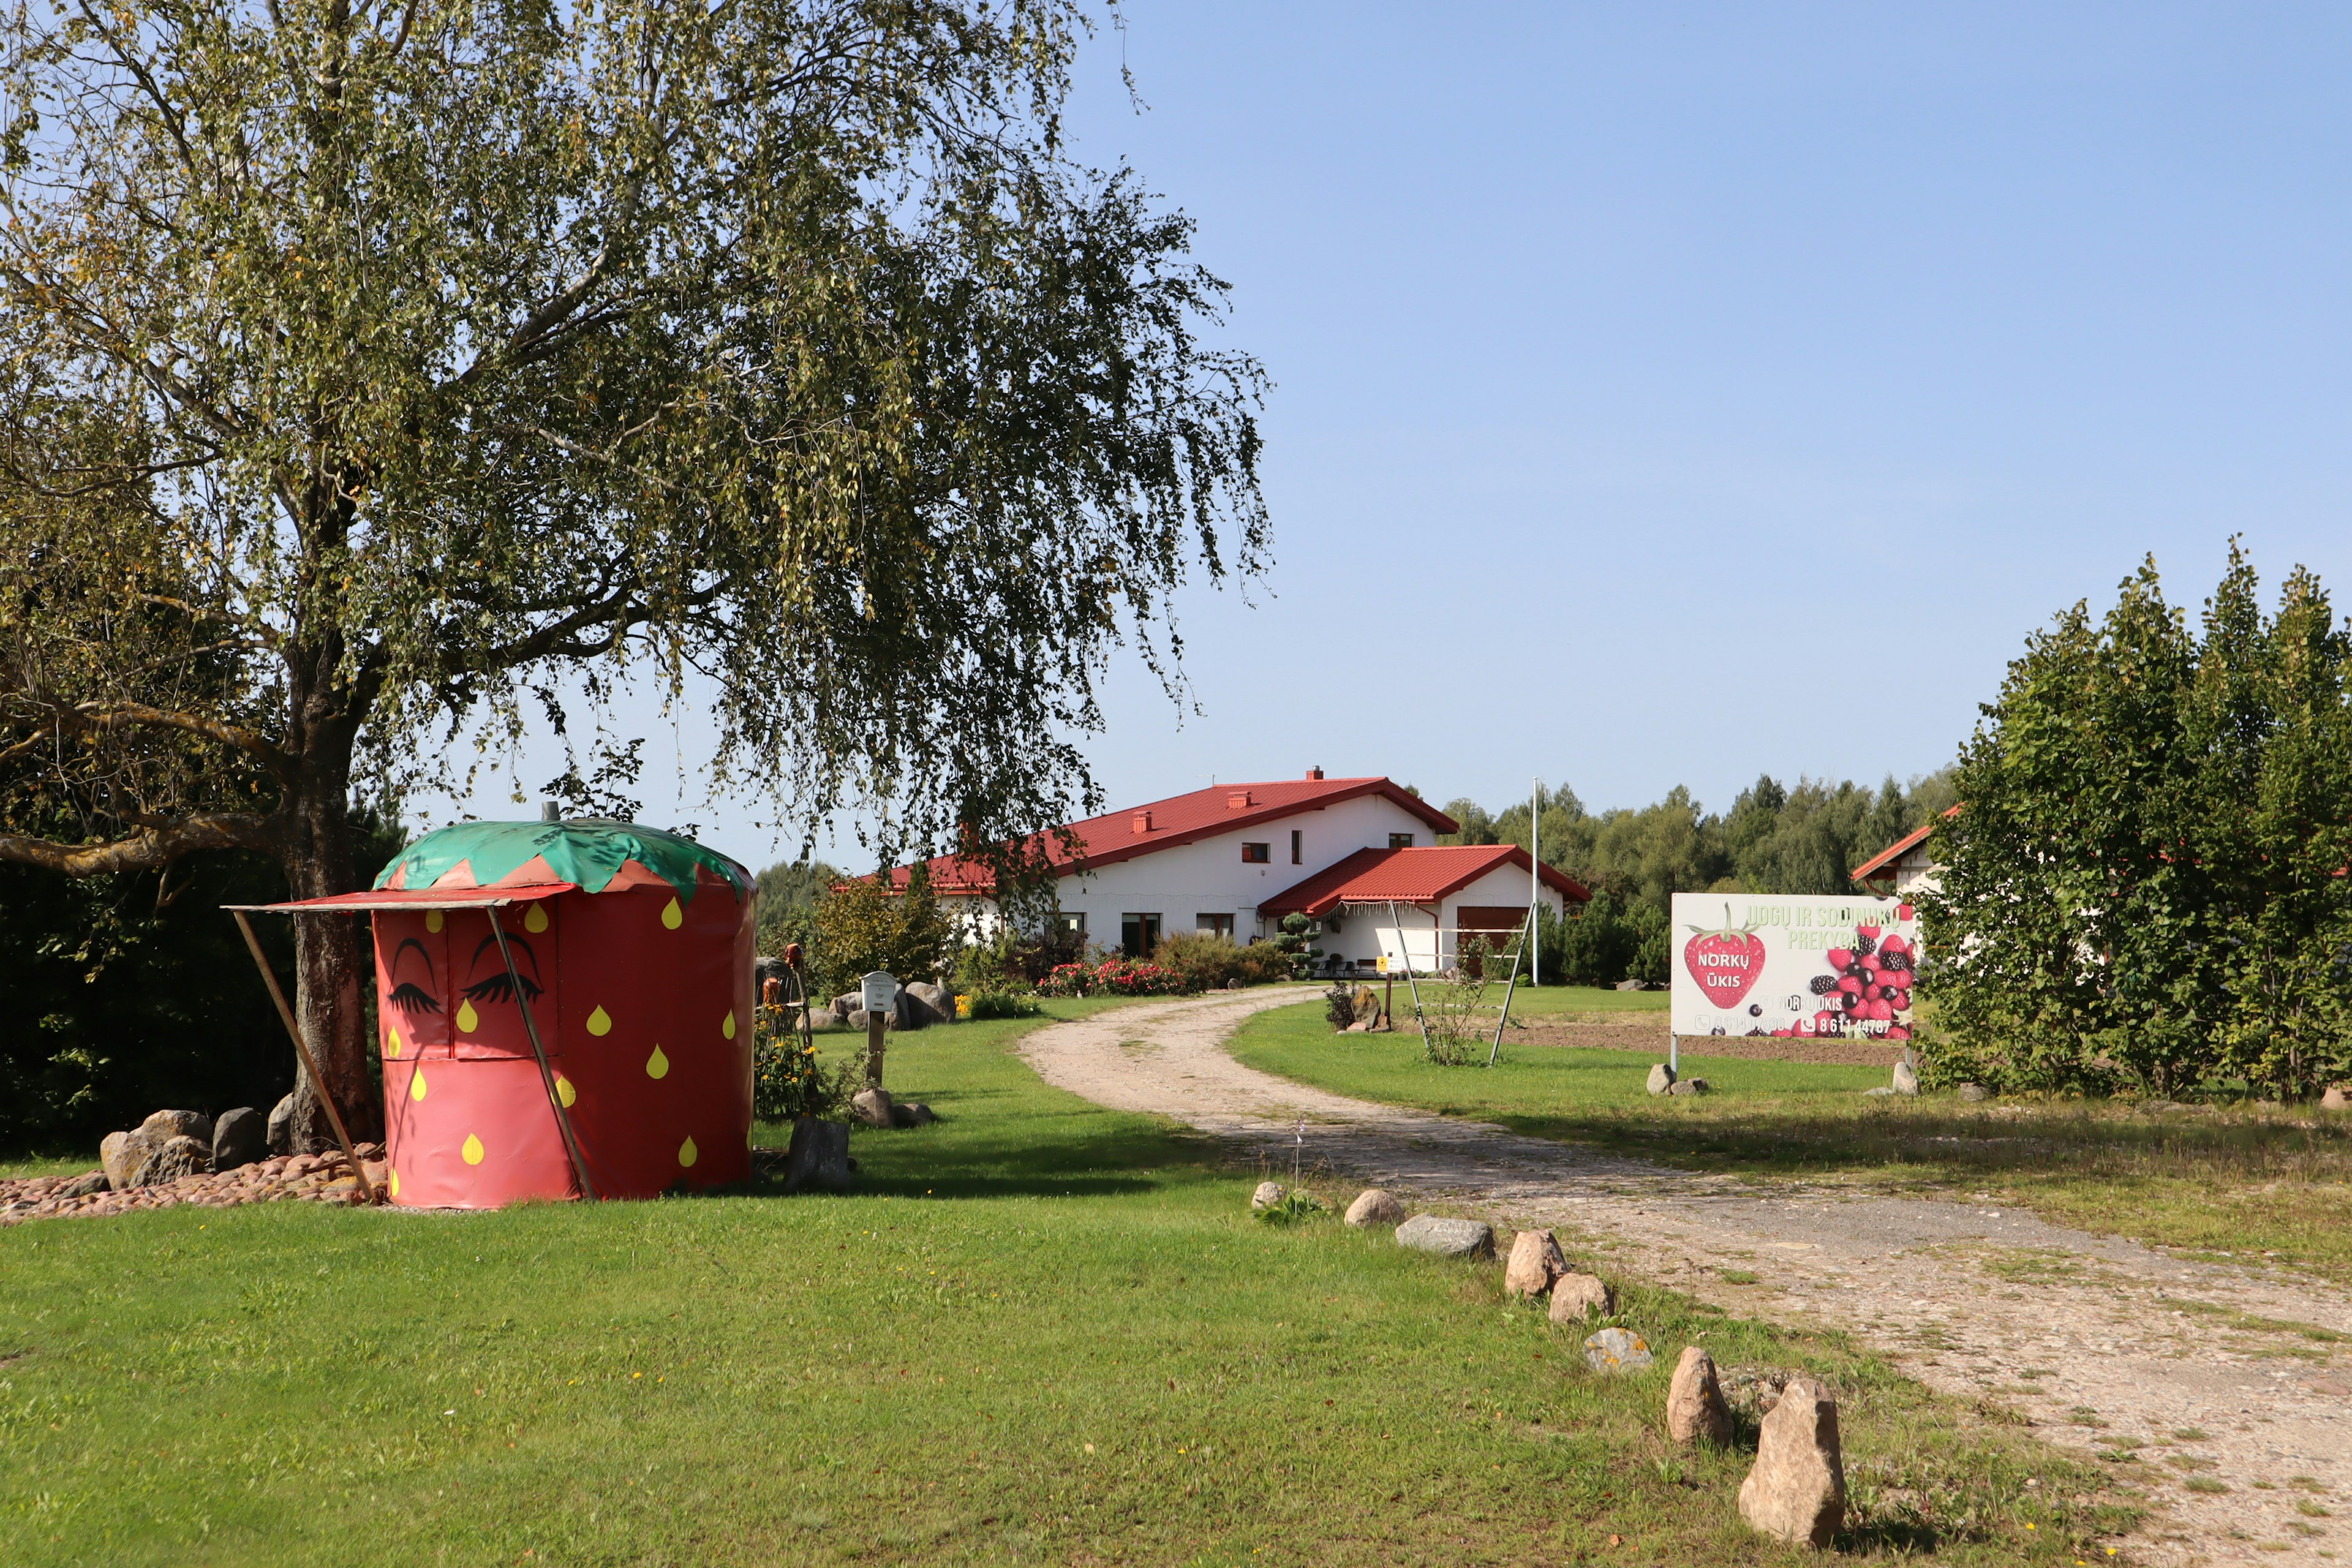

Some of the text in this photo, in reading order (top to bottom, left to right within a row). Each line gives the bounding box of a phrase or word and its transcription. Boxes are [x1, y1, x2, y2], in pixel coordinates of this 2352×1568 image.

[1747, 906, 1901, 932] UOGŲ IR SODINUKŲ
[1788, 930, 1860, 951] PREKYBA
[1698, 954, 1749, 970] NORKŲ
[1706, 972, 1741, 987] ŪKIS
[1778, 995, 1842, 1012] NORKŲ ŪKIS
[1714, 1017, 1785, 1031] 8 614 07690
[1820, 1019, 1891, 1034] 8 611 44787
